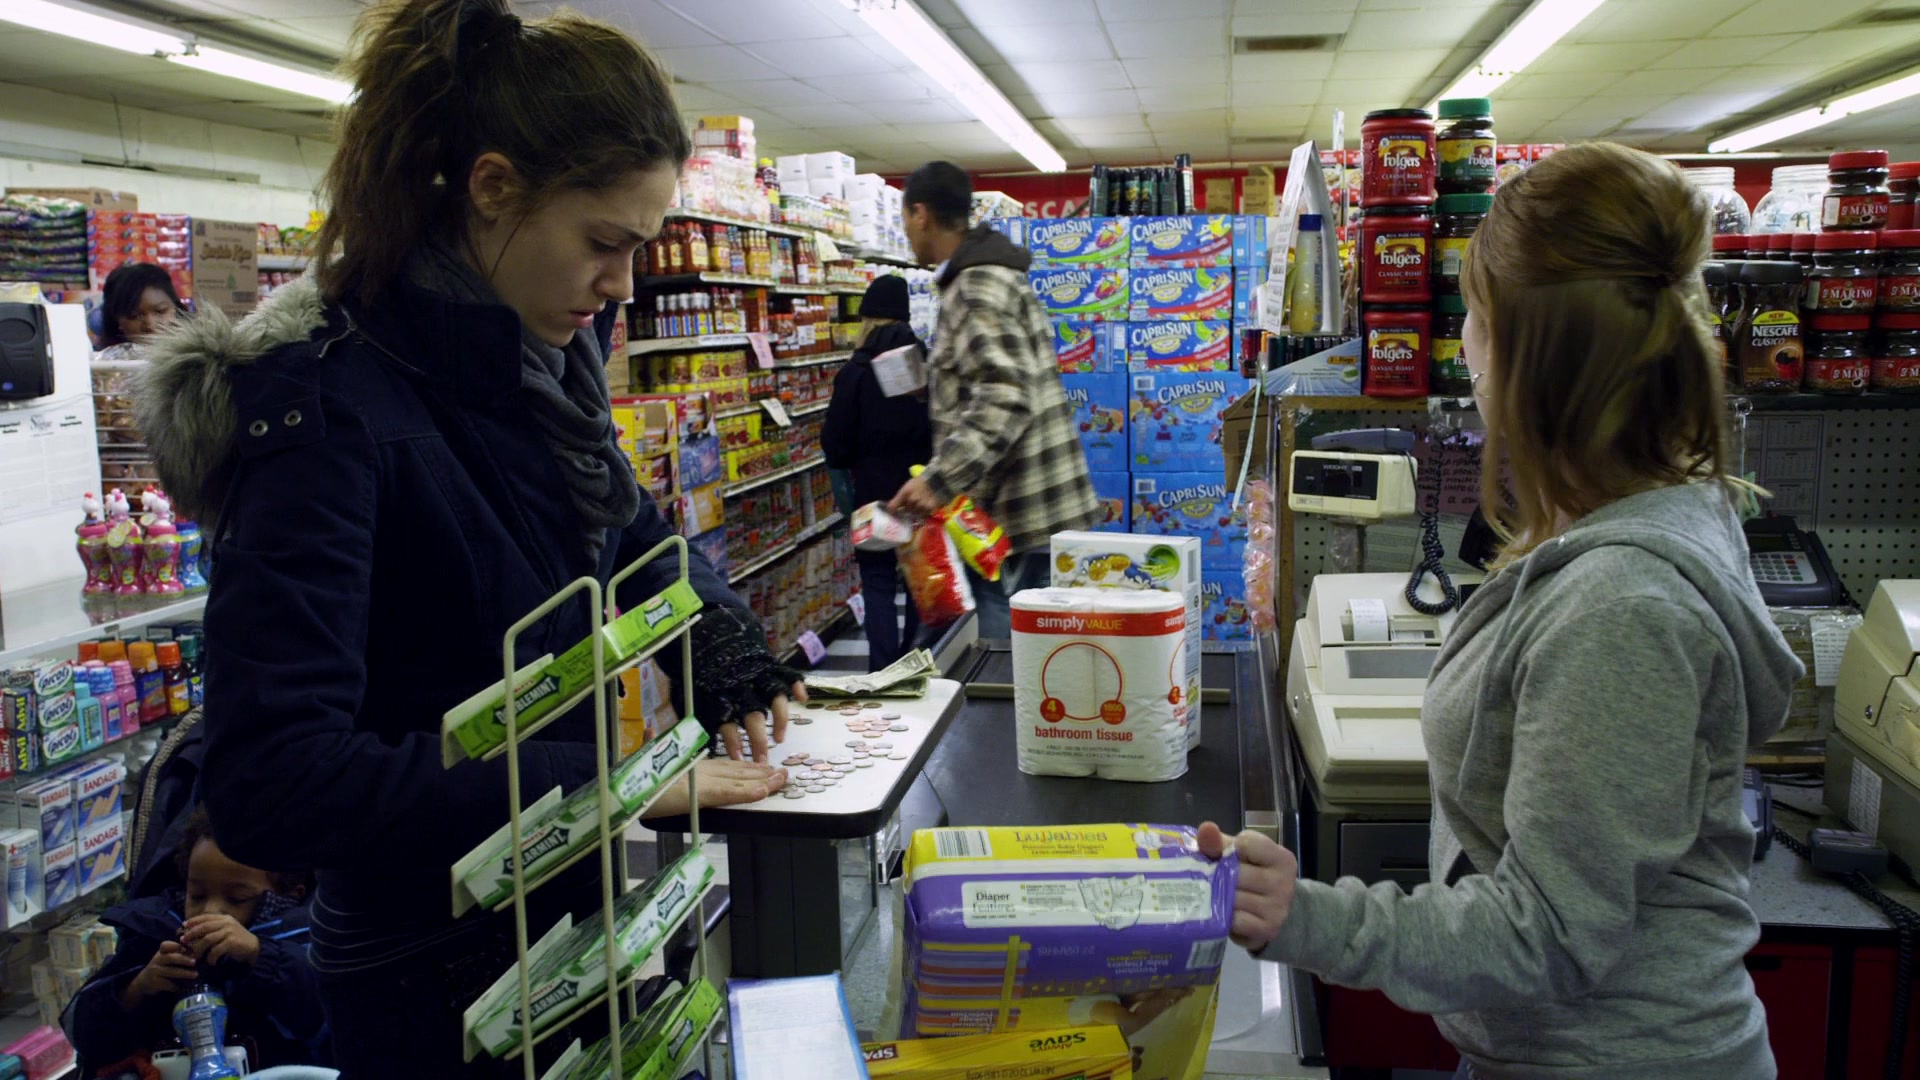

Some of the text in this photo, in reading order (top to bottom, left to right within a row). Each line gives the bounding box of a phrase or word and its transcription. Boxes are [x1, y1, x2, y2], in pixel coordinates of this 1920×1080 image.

[1383, 152, 1421, 169] Folgers
[1380, 250, 1421, 268] Folgers
[1752, 324, 1799, 337] NESCAFÉ
[1372, 345, 1413, 363] Folgers
[495, 675, 557, 724] DBLEMINT
[1046, 700, 1057, 712] 4
[1034, 726, 1134, 742] bathroom tissue
[83, 769, 119, 794] BANDAGE
[83, 825, 119, 850] BANDAGE
[506, 831, 567, 870] SEARMINT
[976, 891, 1010, 904] Diaper
[515, 983, 575, 1022] SEARMINT
